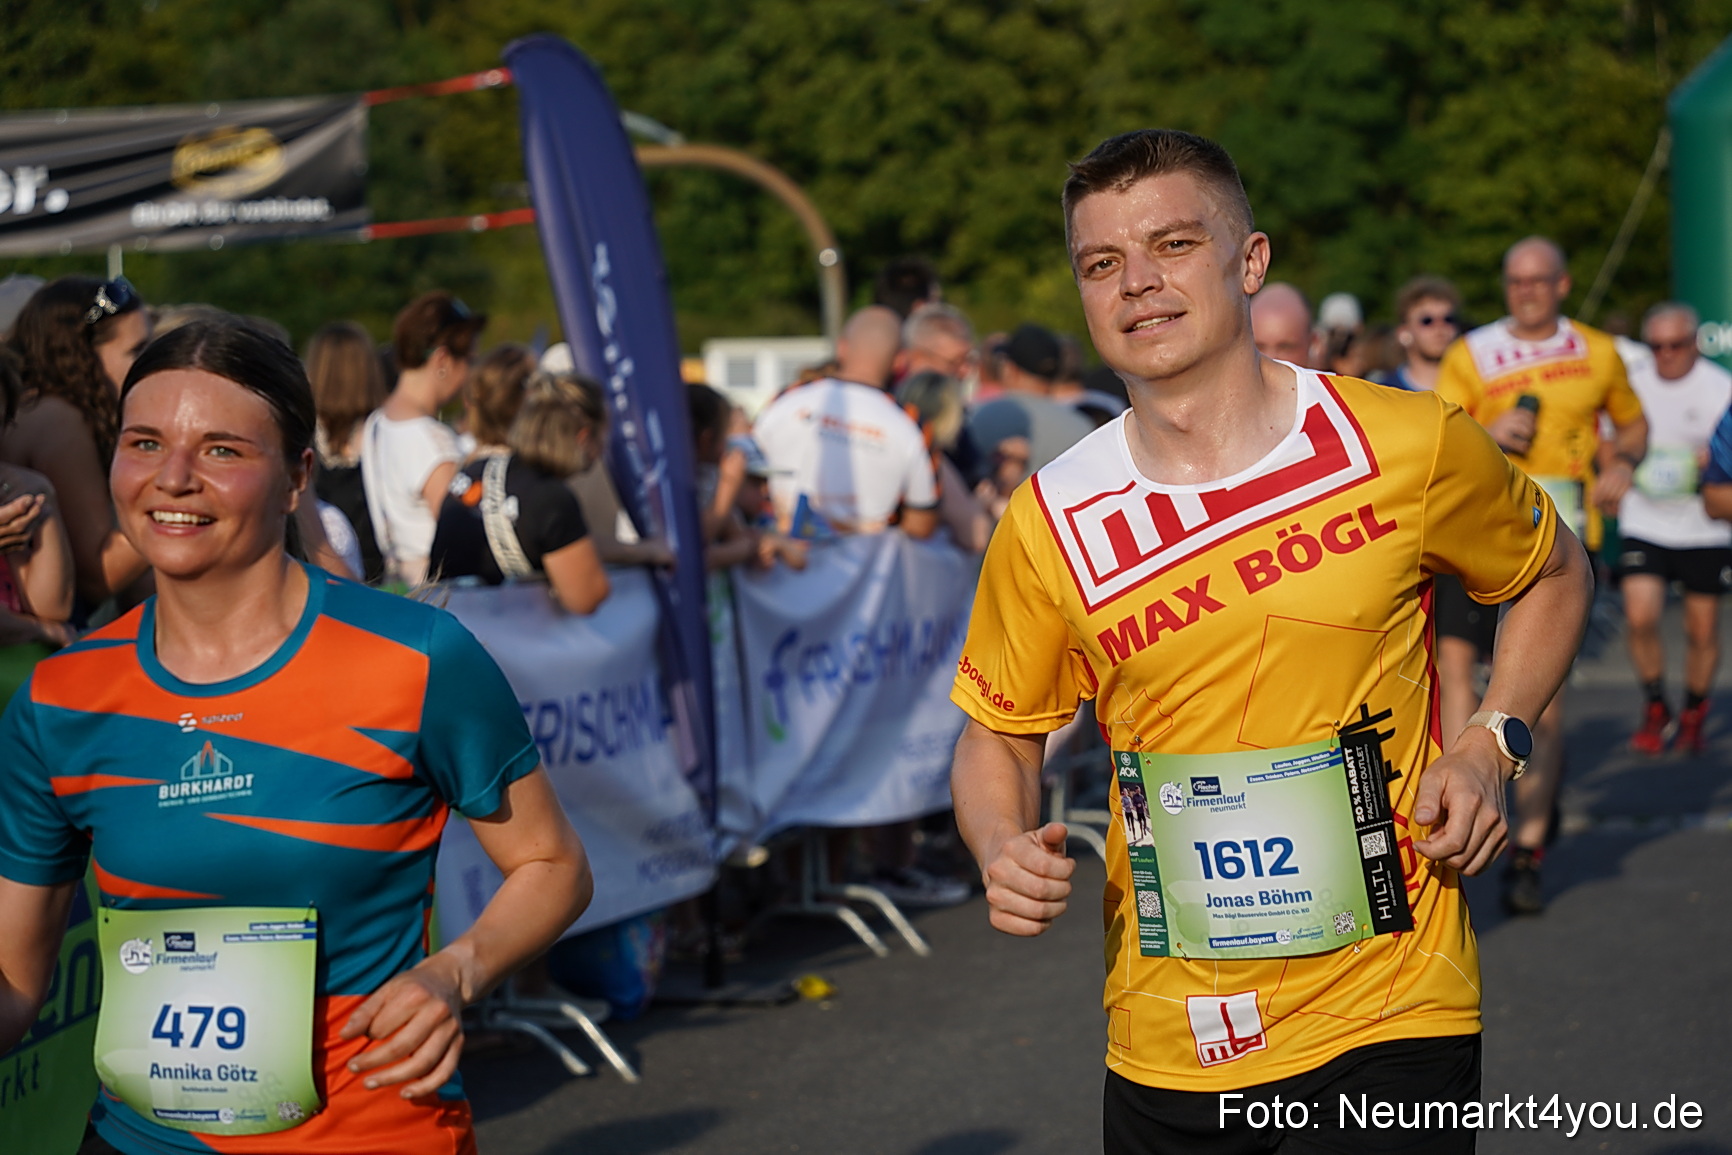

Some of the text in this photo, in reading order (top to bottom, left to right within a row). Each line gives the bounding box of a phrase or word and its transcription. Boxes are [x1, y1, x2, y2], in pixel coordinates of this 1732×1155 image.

[1096, 503, 1398, 668] MAX BÖGL
[1119, 766, 1139, 778] AOK
[1355, 745, 1368, 780] OUTLET
[158, 773, 254, 800] BURKHARDT
[1186, 792, 1246, 808] Firmenlauf
[1344, 747, 1366, 823] 20 % RABATT
[1362, 781, 1375, 820] FACTORY
[1210, 803, 1247, 814] neumarkt
[1194, 837, 1299, 880] 1612
[1205, 889, 1313, 908] Jonas Böhm
[1371, 861, 1393, 920] HILTL
[1211, 935, 1274, 947] firmenlauf.bayern
[152, 1004, 246, 1050] 479
[150, 1063, 258, 1082] Annika Götz
